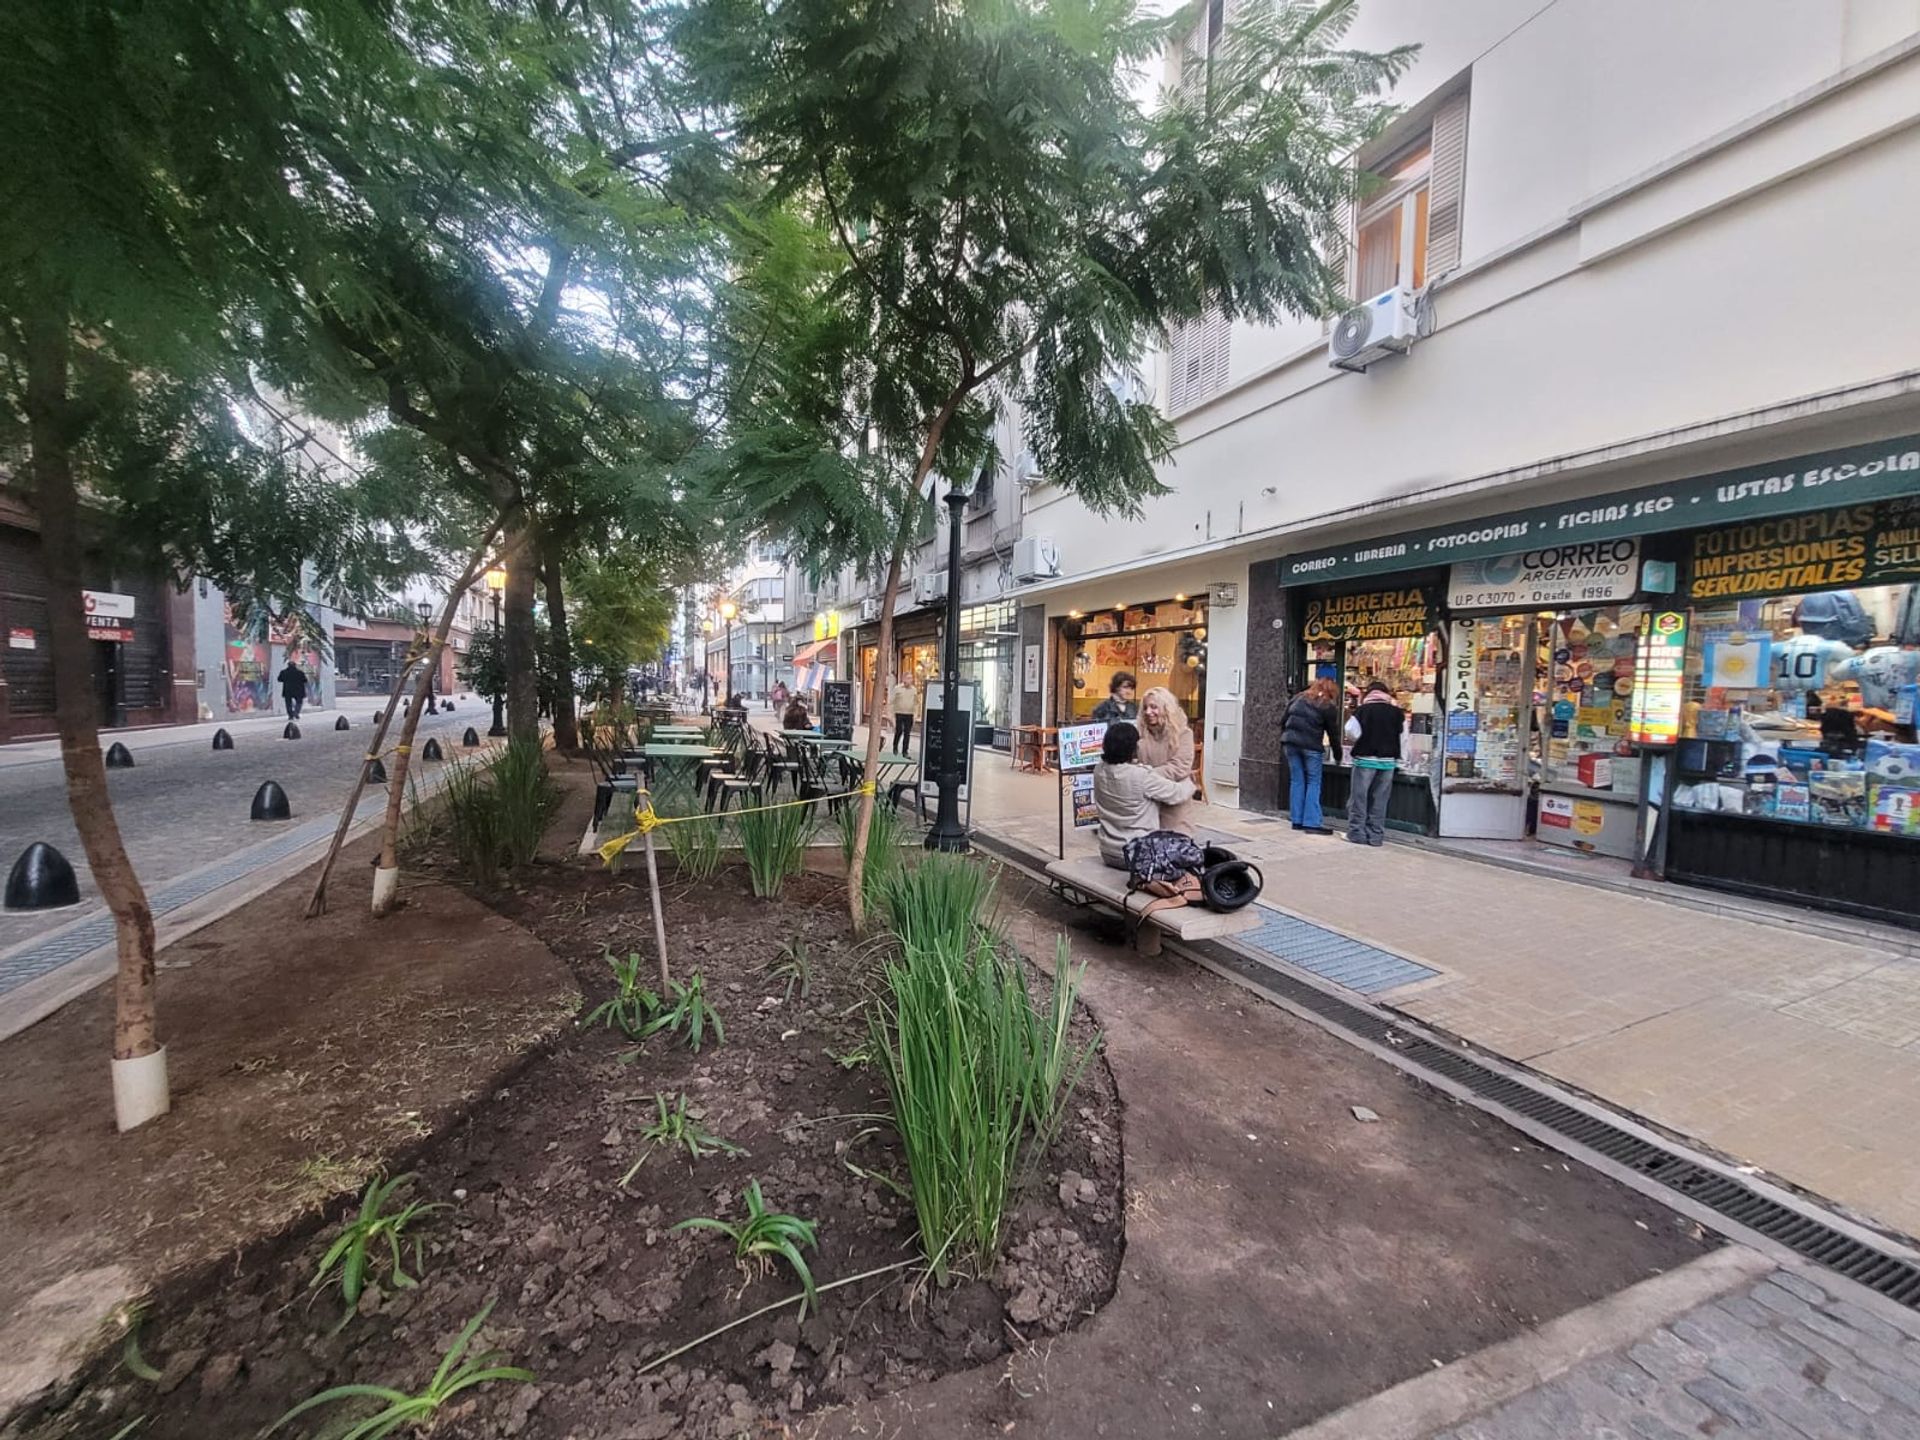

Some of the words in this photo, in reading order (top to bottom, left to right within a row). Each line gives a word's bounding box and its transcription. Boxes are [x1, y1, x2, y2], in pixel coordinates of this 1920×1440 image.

[1292, 556, 1336, 574] CORREO
[1354, 543, 1406, 563] LIBRERIA
[1427, 521, 1529, 552] FOTOCOPIAS
[1558, 503, 1629, 529] FICHAS
[1633, 496, 1675, 517] SEC
[1717, 473, 1796, 503] LISTAS
[1803, 451, 1920, 487] ESCOLA
[1695, 505, 1875, 556] FOTOCOPIAS
[1522, 539, 1635, 569] CORREO
[1694, 535, 1867, 577] IMPRESIONES
[1519, 563, 1629, 584] ARGENTINO
[1325, 588, 1425, 613] LIBRERIA
[1532, 589, 1572, 602] Desde
[1581, 586, 1613, 599] 1996
[1357, 621, 1424, 638] ARTISTICA
[1778, 652, 1818, 679] 10
